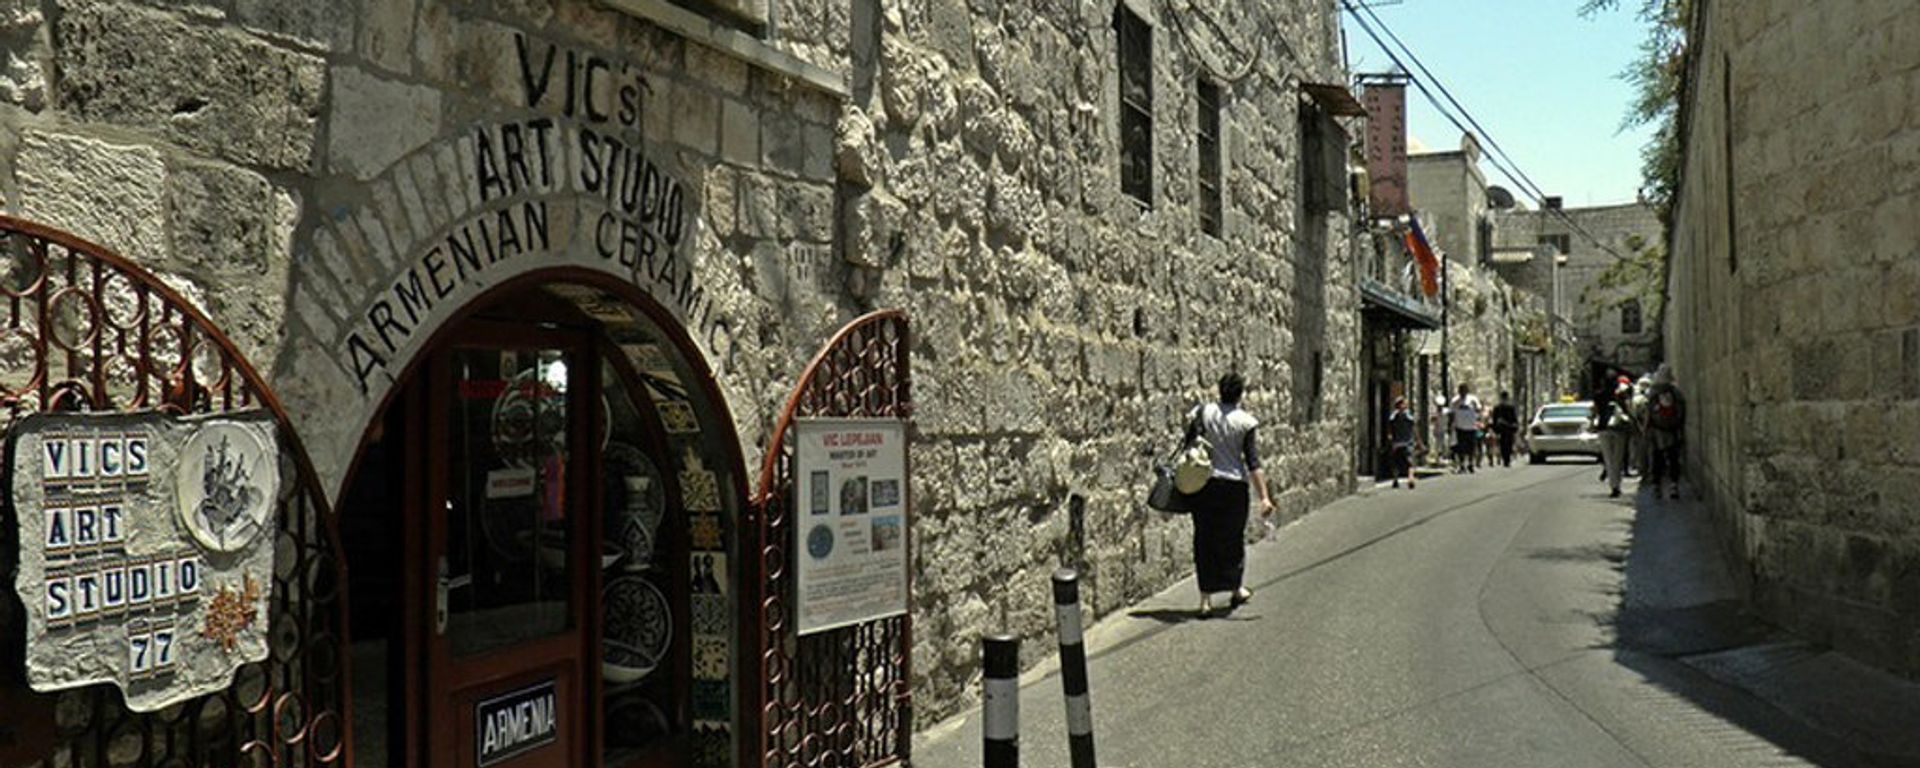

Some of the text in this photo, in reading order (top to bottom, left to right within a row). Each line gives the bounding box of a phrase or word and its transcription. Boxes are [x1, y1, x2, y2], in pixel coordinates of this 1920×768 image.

[477, 118, 684, 247] ART STUDIO
[347, 201, 549, 395] ARMENIAN
[46, 440, 146, 475] VICS
[49, 507, 122, 545] ART
[49, 560, 197, 617] STUDIO
[131, 632, 174, 669] 77
[482, 693, 556, 755] ARMENIA
